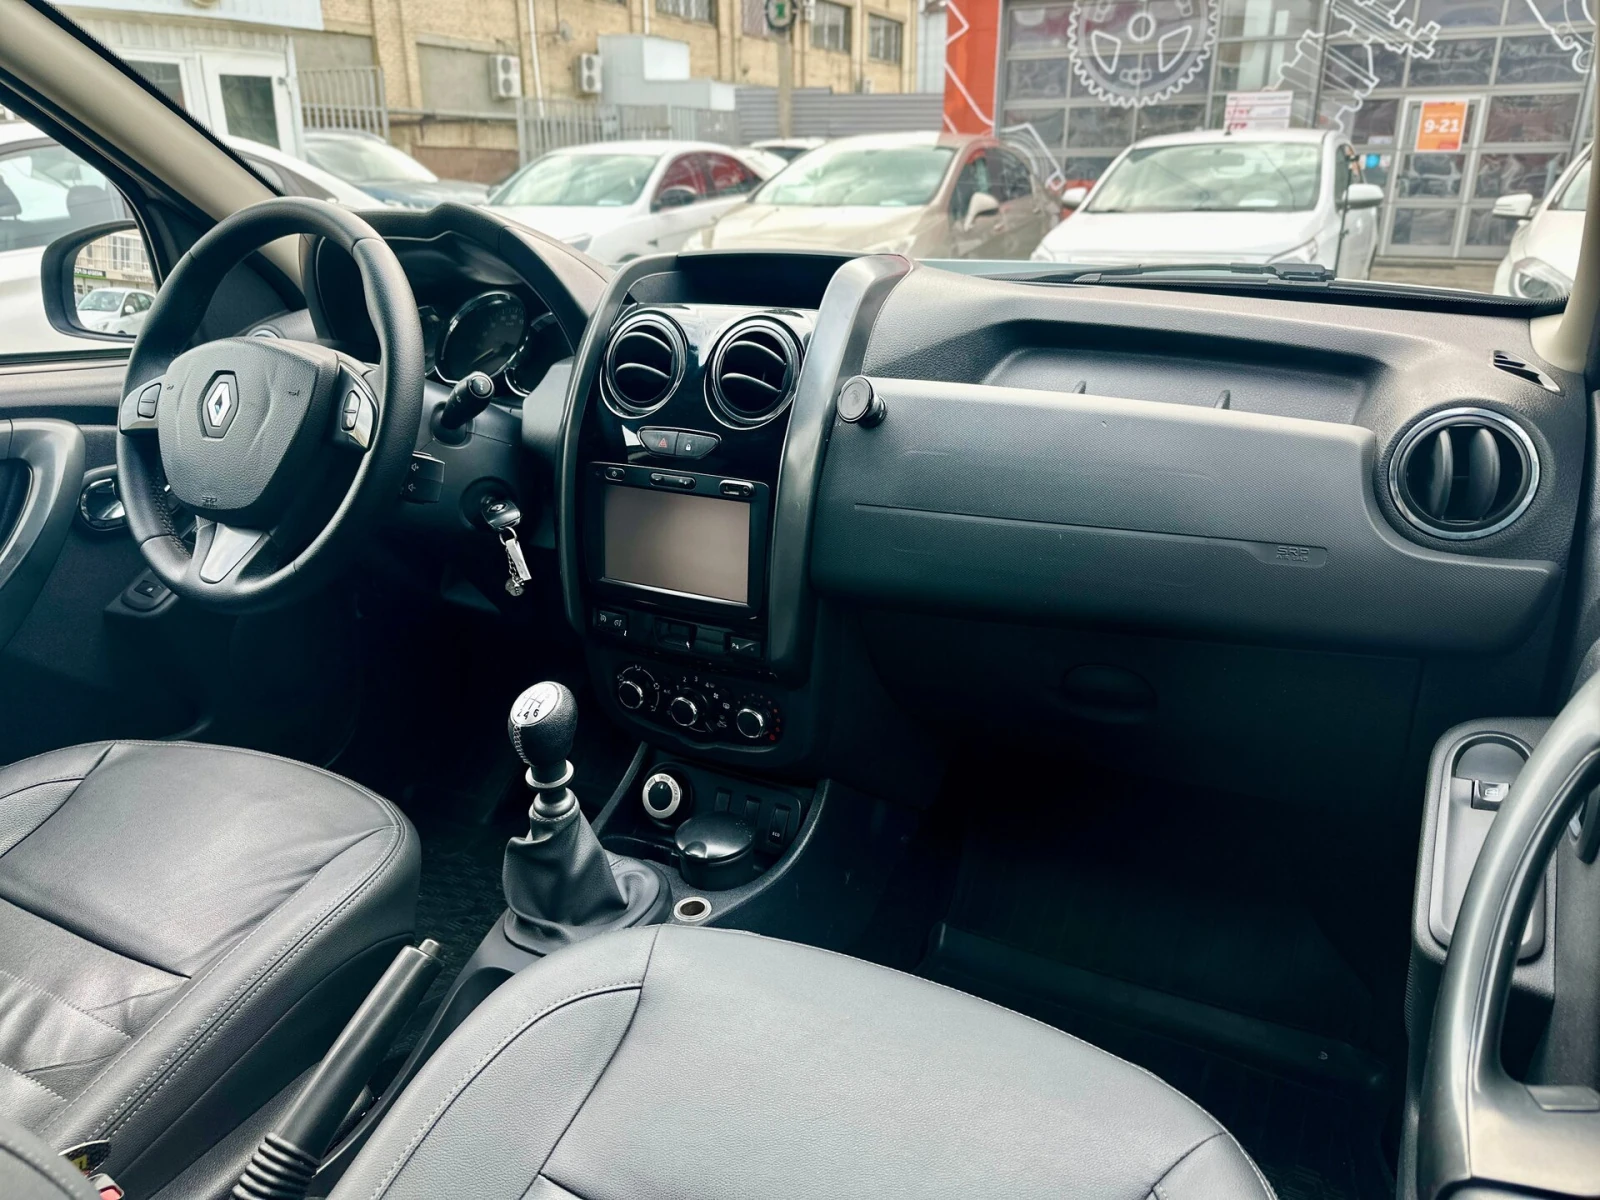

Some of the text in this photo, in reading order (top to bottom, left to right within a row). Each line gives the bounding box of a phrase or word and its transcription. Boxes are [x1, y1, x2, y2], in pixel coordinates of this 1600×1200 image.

[1424, 119, 1460, 133] 9-21
[523, 711, 529, 720] 4
[533, 709, 540, 718] 6
